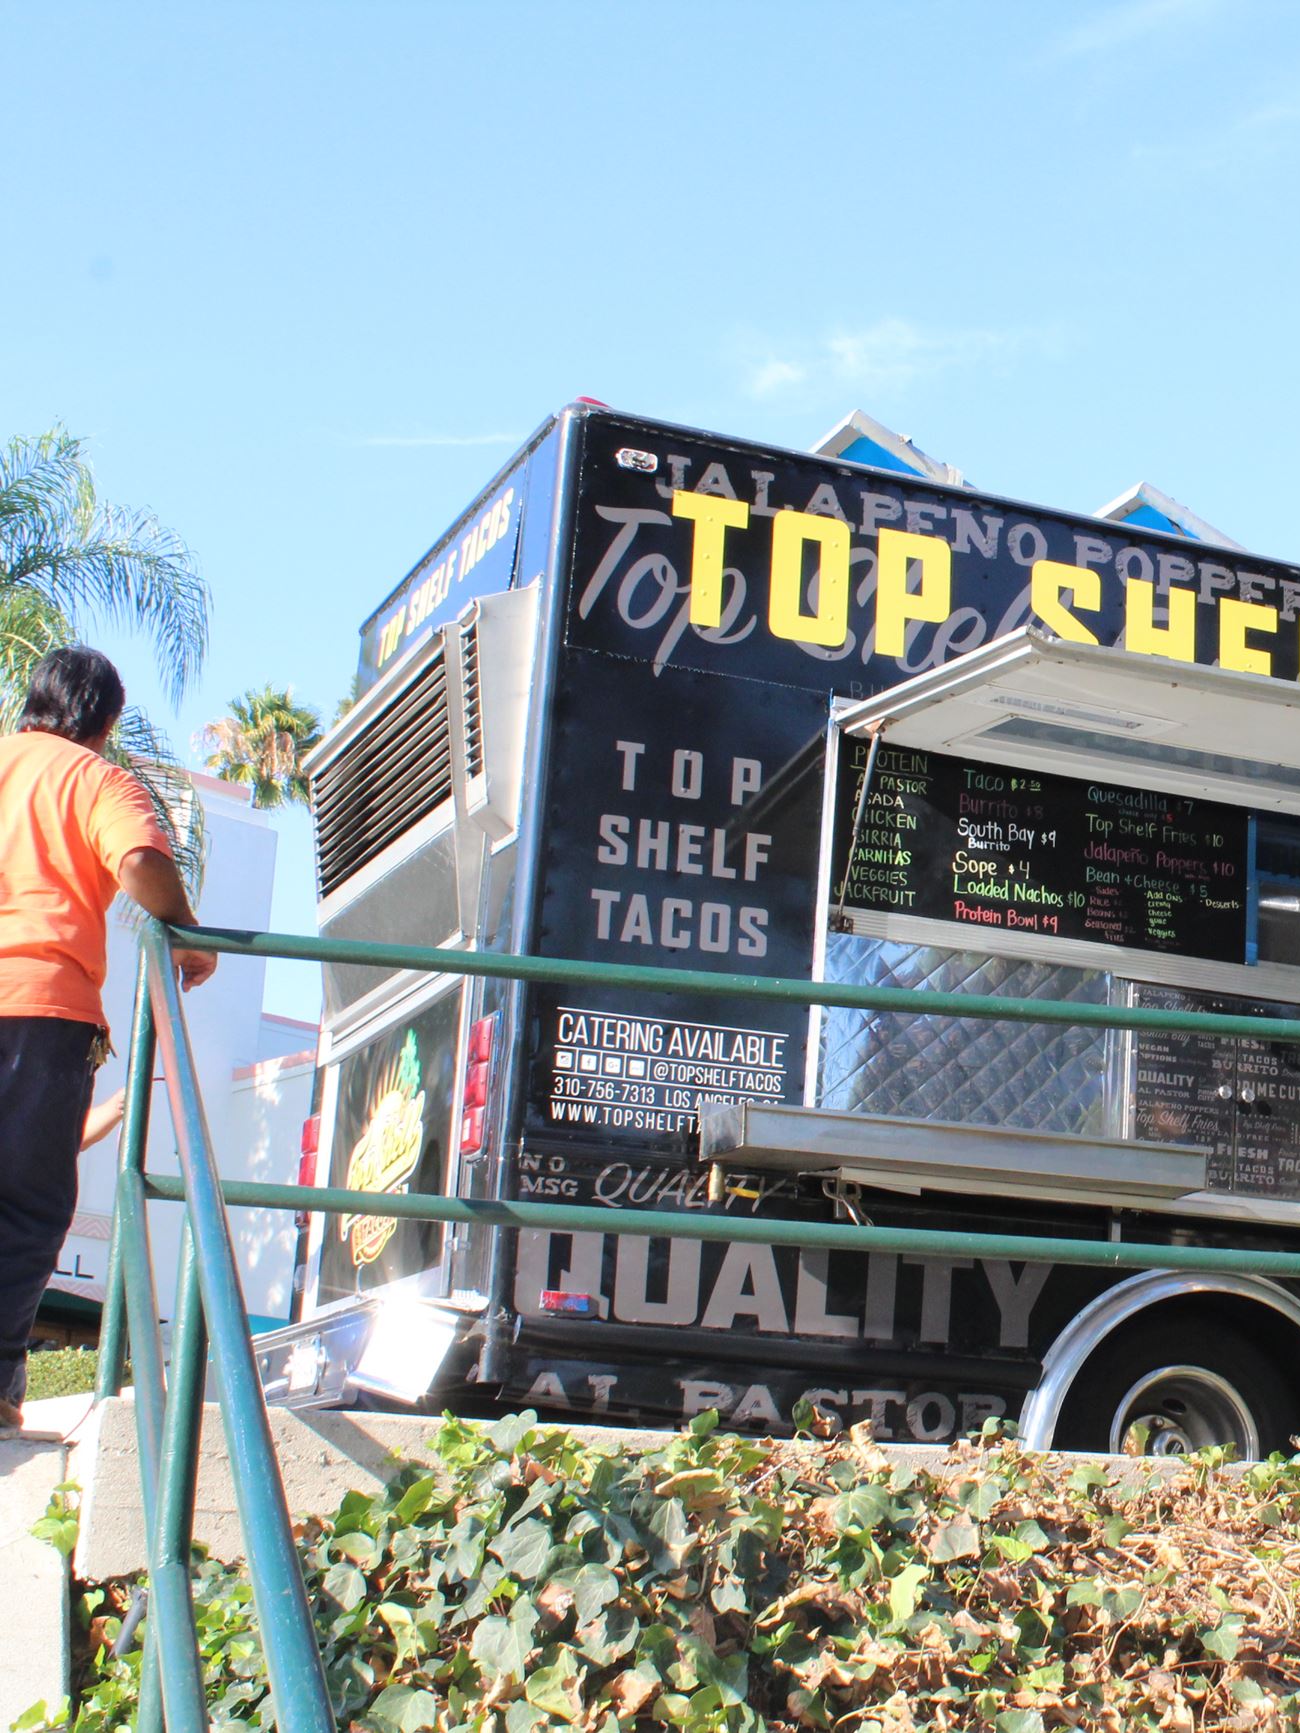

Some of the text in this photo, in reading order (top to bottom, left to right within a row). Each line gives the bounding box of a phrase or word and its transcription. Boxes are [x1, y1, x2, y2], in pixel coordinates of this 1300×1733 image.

[672, 488, 951, 658] TOP
[616, 740, 762, 806] TOP
[855, 745, 928, 774] POTEIN
[880, 775, 928, 796] PASTOR
[964, 768, 1004, 791] Taco
[960, 792, 1018, 819] Burrito
[1087, 785, 1167, 813] Quesadilla
[957, 817, 1003, 841] South
[1008, 822, 1035, 849] Bay
[968, 836, 1011, 852] Burrito
[1085, 812, 1113, 839] Top
[1119, 817, 1158, 839] Shelf
[1162, 825, 1198, 847] Fries
[598, 814, 772, 882] SHELF
[1084, 840, 1149, 868] Jalapeño
[1156, 849, 1208, 876] Poppers
[851, 865, 908, 887] VEGGIES
[952, 850, 998, 879] Sope
[1086, 866, 1120, 884] Bean
[834, 881, 916, 907] JACKFRUIT
[953, 874, 1086, 909] Loaded Nachos $10
[591, 888, 768, 957] TACOS
[954, 900, 1002, 924] Protein
[1007, 908, 1038, 931] Bowl
[557, 1012, 785, 1069] CATERING AVAILABLE
[1242, 1054, 1278, 1066] TACOS
[652, 1061, 781, 1093] @TOPSHELFTACOS
[1137, 1069, 1195, 1088] QUALITY
[553, 1076, 656, 1105] 310-756-7313
[664, 1088, 691, 1109] LOS
[1154, 1088, 1190, 1098] PASTOR
[1136, 1107, 1154, 1128] Top
[1160, 1110, 1190, 1134] Shelf
[1191, 1114, 1219, 1132] Fries
[522, 1153, 566, 1174] NO
[1240, 1163, 1274, 1175] TACOS
[520, 1174, 579, 1197] MSG
[592, 1161, 788, 1213] QUALTY
[513, 1227, 1053, 1349] QUALITY
[680, 1379, 1010, 1440] PASTOR
